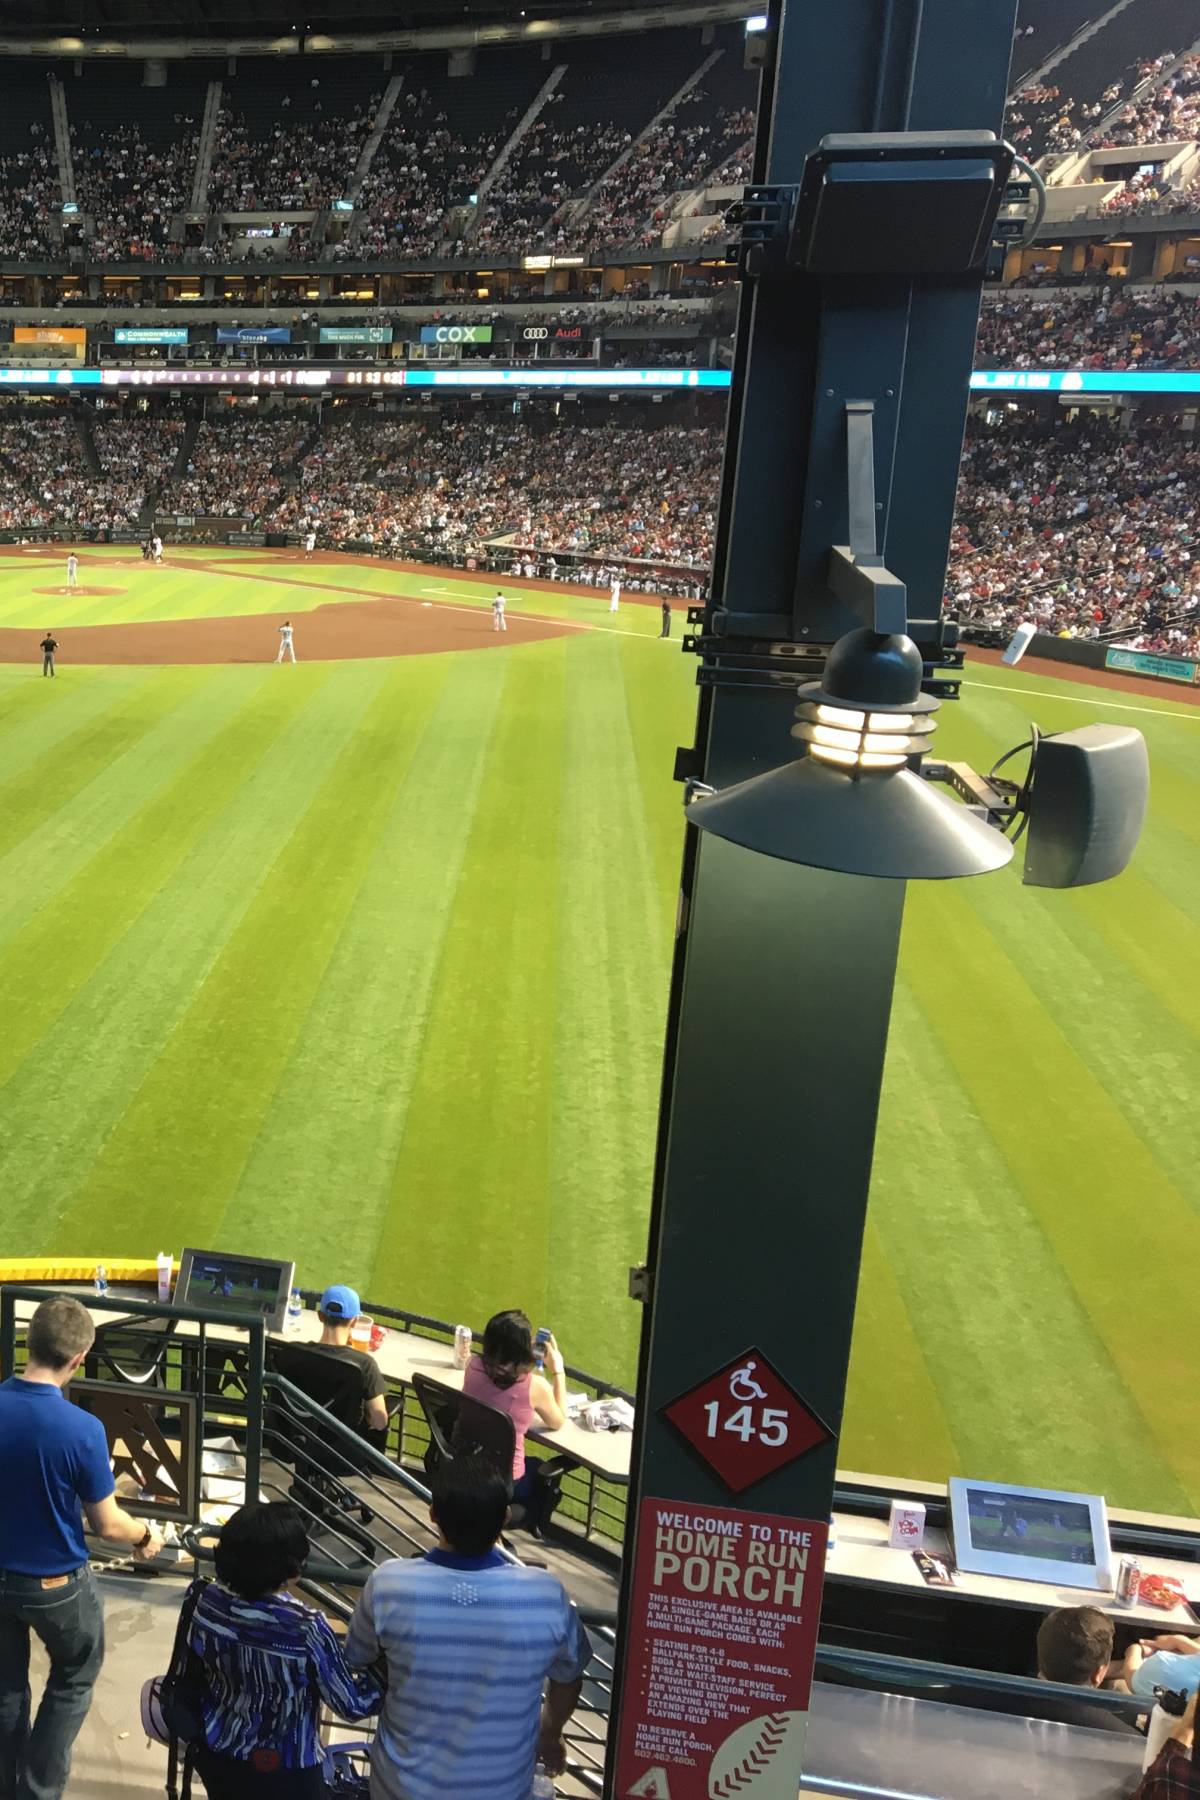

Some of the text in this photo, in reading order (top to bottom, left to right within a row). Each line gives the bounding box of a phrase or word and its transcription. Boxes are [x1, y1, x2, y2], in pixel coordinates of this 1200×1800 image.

[436, 327, 476, 342] COX
[555, 328, 581, 338] Audi
[703, 1400, 789, 1448] 145
[656, 1512, 812, 1547] WELCOME TO THE
[655, 1528, 809, 1571] HOME RUN
[654, 1552, 804, 1607] PORCH
[648, 1603, 660, 1611] ON
[671, 1606, 729, 1622] SINGLE-GAME
[731, 1616, 757, 1626] BASIS
[760, 1620, 772, 1629] OR
[775, 1622, 786, 1631] AS
[649, 1594, 803, 1624] THIS EXCLUSIVE AREA IS AVAILABLE
[647, 1620, 785, 1648] HOME RUN PORCH COMES WITH:
[656, 1613, 709, 1627] MULTI-GAME
[756, 1628, 780, 1638] EACH
[654, 1639, 689, 1651] SEATING
[691, 1645, 708, 1654] FOR
[652, 1657, 674, 1666] SODA
[687, 1662, 716, 1673] WATER
[653, 1648, 724, 1666] BALLPARK-STYLE
[754, 1664, 792, 1677] SNACKS,
[651, 1666, 775, 1692] IN-SEAT WAIT-STAFF SERVICE
[659, 1676, 693, 1687] PRIVATE
[696, 1681, 747, 1696] TELEVISION,
[749, 1690, 787, 1702] PERFECT
[650, 1683, 665, 1692] FOR
[668, 1686, 704, 1698] VIEWING
[648, 1700, 729, 1719] EXTENDS OVER THE
[663, 1694, 702, 1706] AMAZING
[704, 1700, 726, 1710] VIEW
[729, 1704, 751, 1713] THAT
[647, 1709, 707, 1725] PLAYING FIELD
[636, 1732, 715, 1752] HOME RUN PORCH,
[637, 1724, 696, 1740] TO RESERVE A
[635, 1741, 689, 1756] PLEASE CALL
